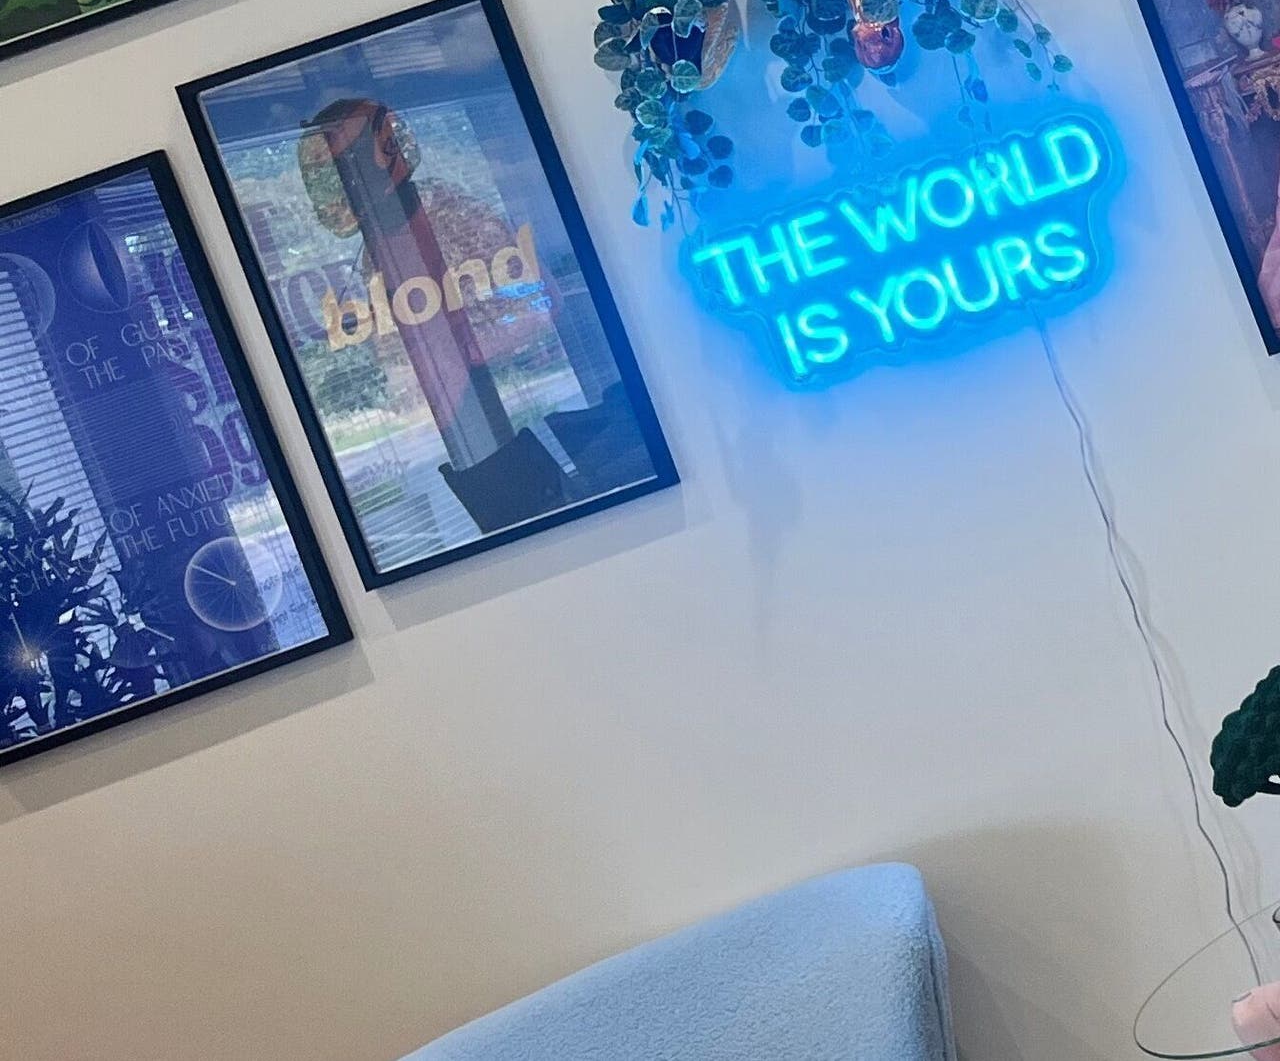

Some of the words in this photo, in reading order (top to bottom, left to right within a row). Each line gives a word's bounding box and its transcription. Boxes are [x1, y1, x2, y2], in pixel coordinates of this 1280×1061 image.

[693, 210, 848, 306] THE
[838, 123, 1101, 254] WORLD
[319, 222, 545, 352] blond
[776, 303, 850, 377] IS
[848, 221, 1087, 343] YOURS
[62, 334, 104, 368] OF
[78, 355, 125, 391] THE
[140, 331, 193, 368] PAST
[107, 501, 148, 535] OF
[113, 524, 163, 561] THE
[165, 498, 239, 543] FUTU
